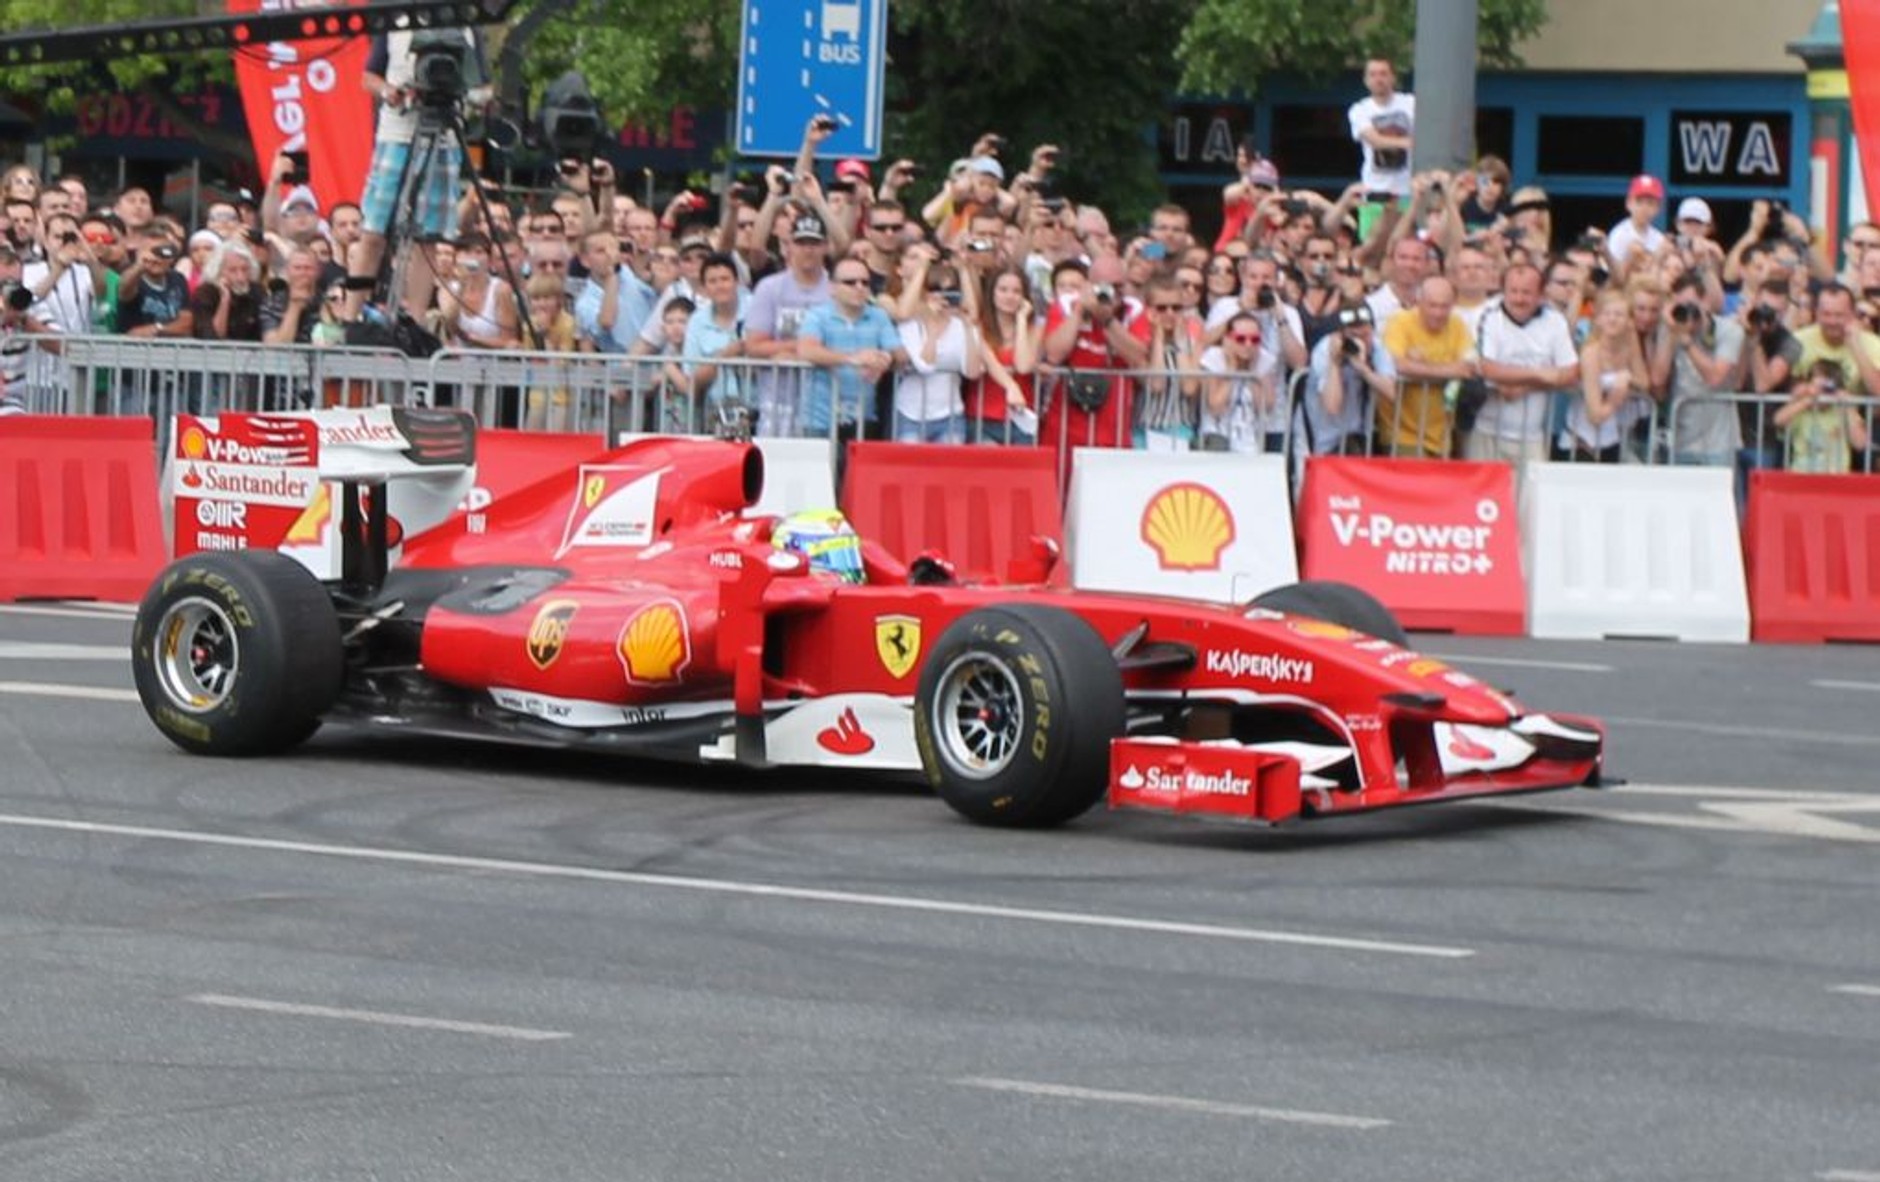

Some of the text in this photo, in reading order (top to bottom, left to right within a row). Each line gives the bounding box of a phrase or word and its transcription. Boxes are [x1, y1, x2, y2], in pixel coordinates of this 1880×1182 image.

[819, 42, 860, 64] BUS
[1680, 121, 1780, 174] WA
[320, 414, 396, 443] ander
[205, 466, 308, 498] Santander
[1329, 512, 1491, 550] V-Power
[709, 551, 743, 568] HUBL
[1207, 648, 1304, 682] KASPERSKY
[1018, 652, 1050, 761] ZERO
